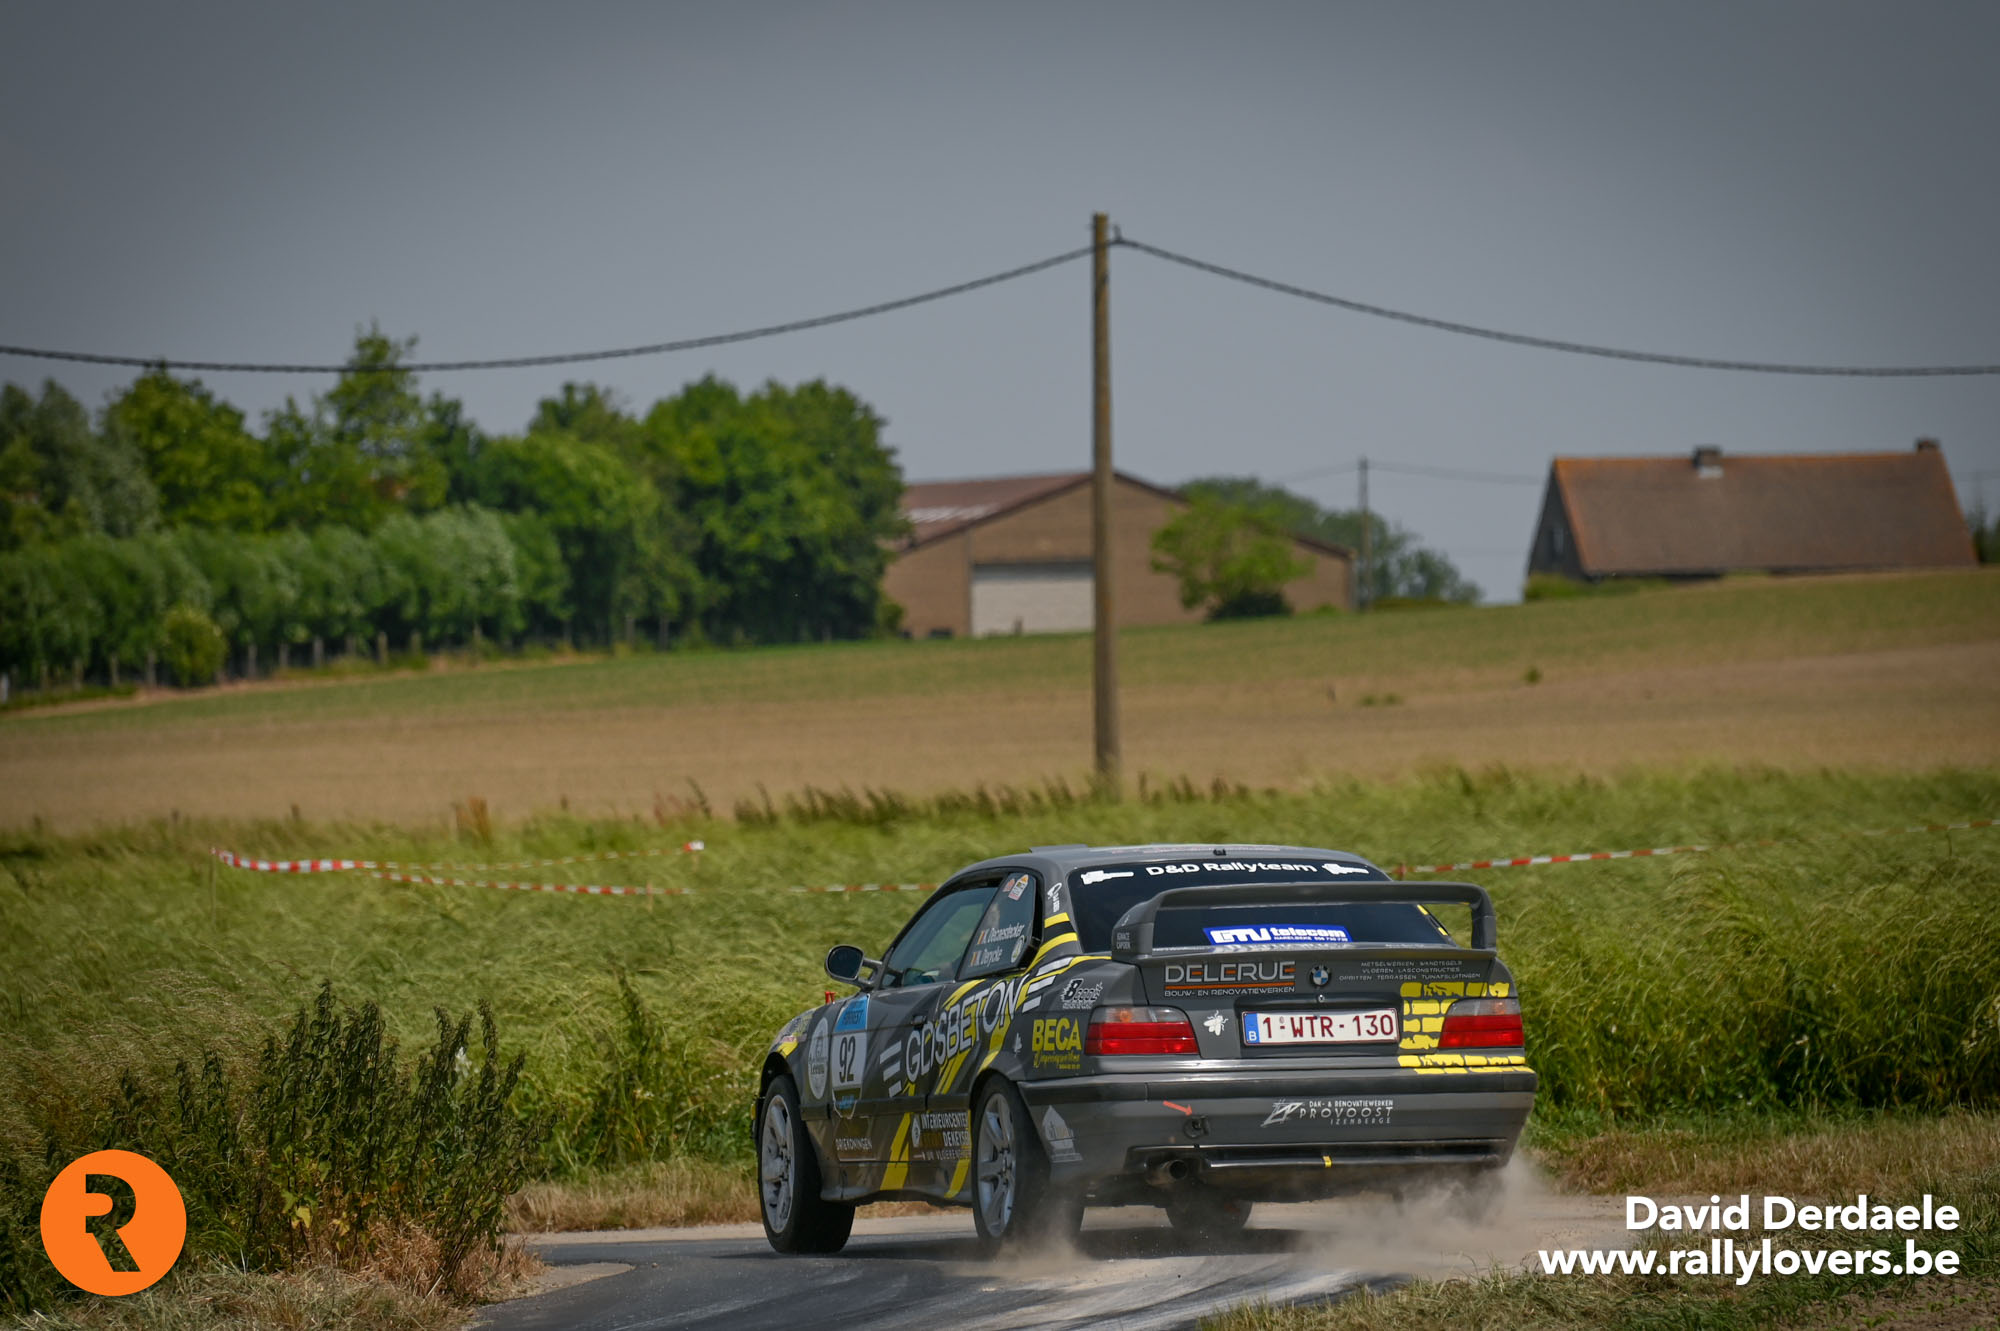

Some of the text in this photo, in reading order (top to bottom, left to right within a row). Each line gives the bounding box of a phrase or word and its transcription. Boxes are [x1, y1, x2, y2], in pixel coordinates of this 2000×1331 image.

[1145, 861, 1318, 876] D&D Rallyteam
[1270, 927, 1347, 938] telecom
[1165, 961, 1296, 983] DELERUE
[1211, 986, 1295, 996] RENOVATIEWERKEN
[1032, 1017, 1082, 1051] BECA
[1248, 1030, 1257, 1042] B
[839, 1035, 856, 1084] 92
[1309, 1100, 1325, 1108] DAK-
[1335, 1099, 1393, 1108] RENOVATIEWERKEN
[1300, 1107, 1393, 1119] PROVOOST
